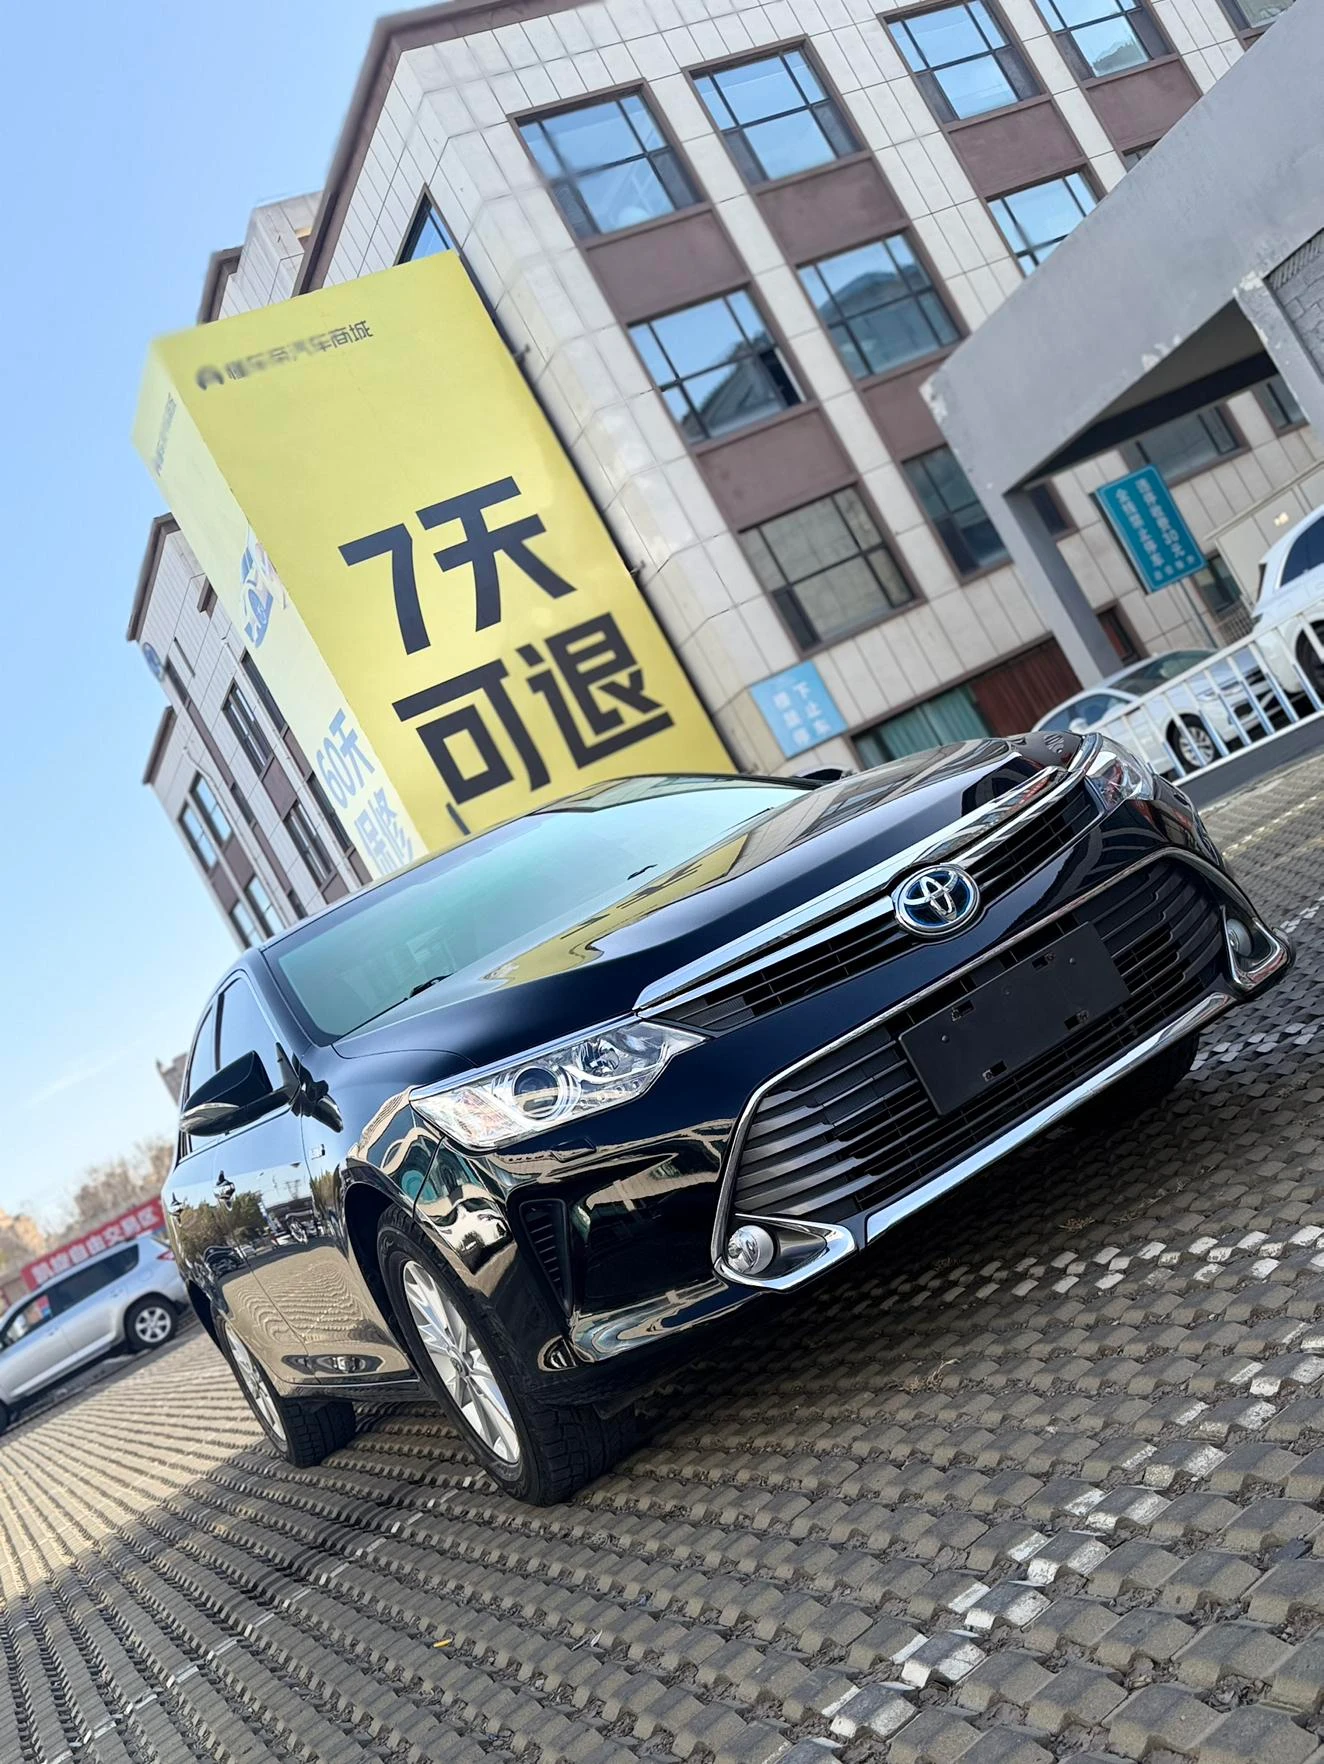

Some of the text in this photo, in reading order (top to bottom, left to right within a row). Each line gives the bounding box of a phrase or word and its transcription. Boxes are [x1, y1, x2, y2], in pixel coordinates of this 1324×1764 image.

[338, 476, 578, 655] 7天
[316, 707, 375, 809] 60天
[392, 611, 675, 805] 可退
